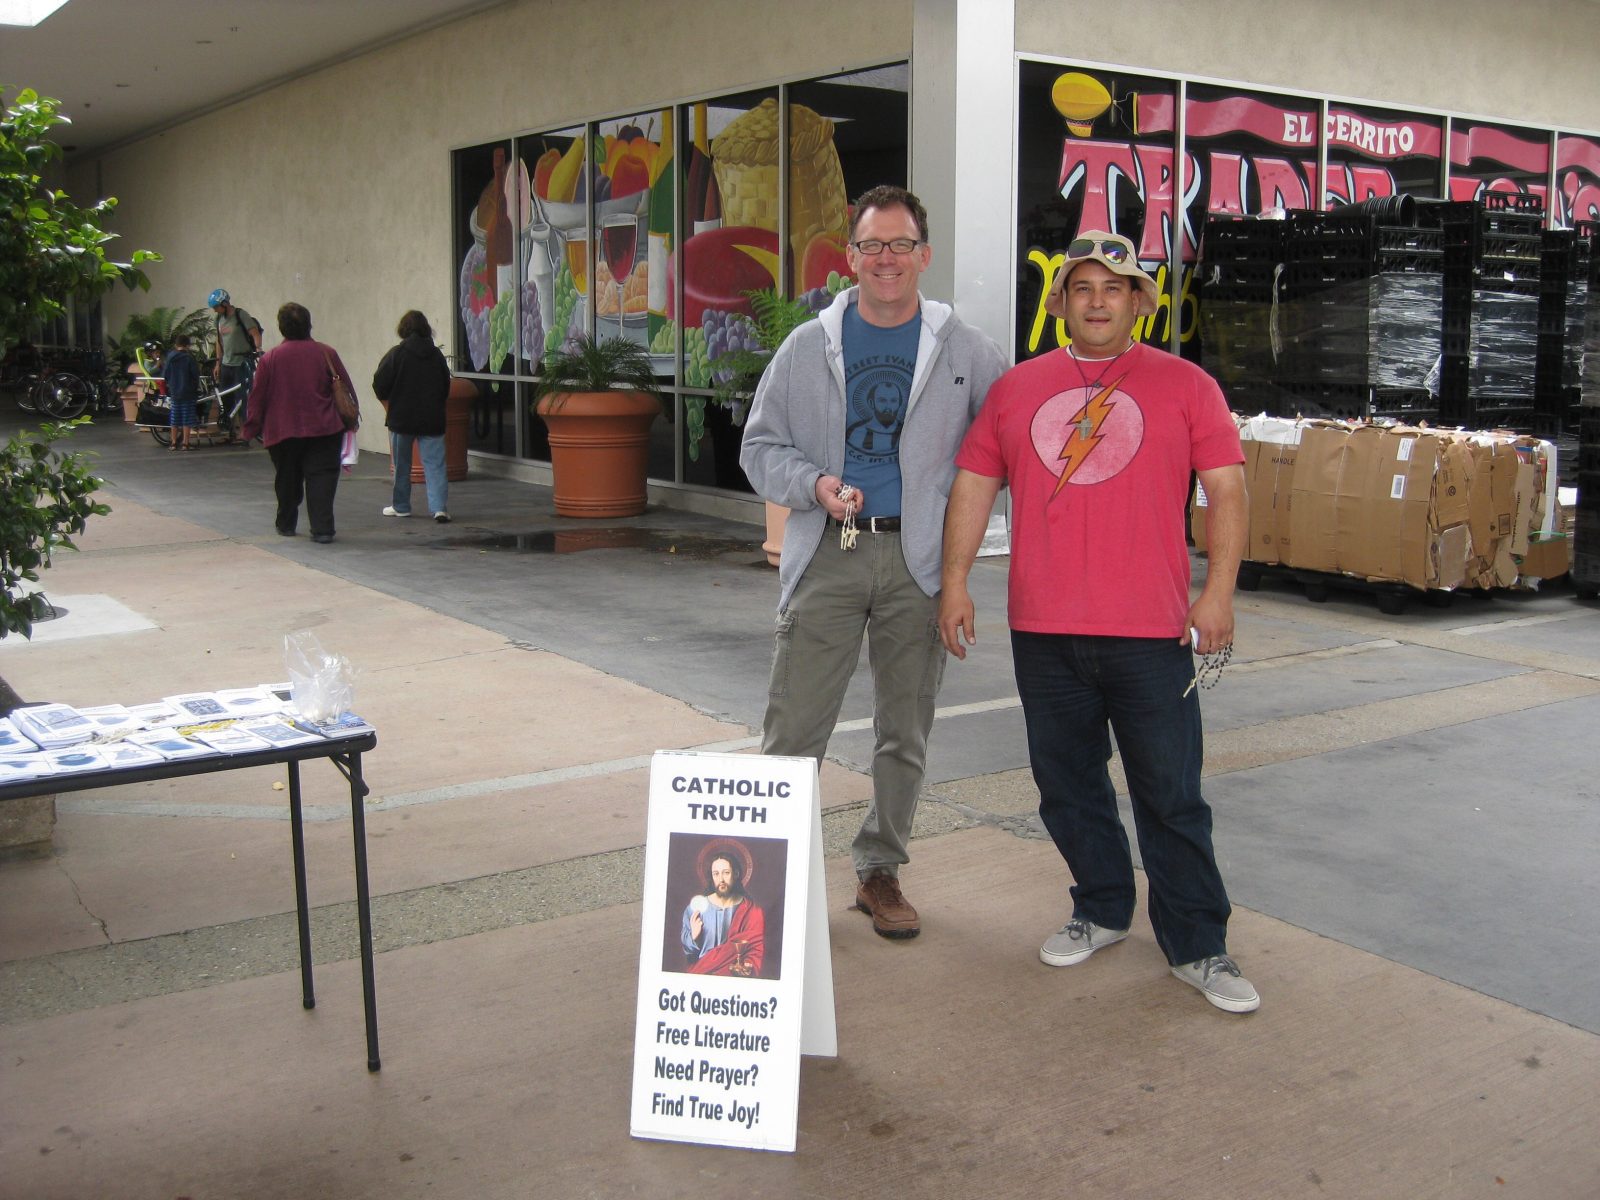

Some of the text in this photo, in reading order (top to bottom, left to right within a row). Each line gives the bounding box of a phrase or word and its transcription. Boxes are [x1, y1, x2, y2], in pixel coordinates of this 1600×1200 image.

[1283, 113, 1414, 155] EL CERRITO
[672, 776, 791, 798] CATHOLIC
[688, 803, 767, 823] TRUTH
[659, 988, 778, 1019] Got Questions?
[656, 1021, 770, 1052] Free Literature
[654, 1056, 759, 1090] Need Prayer?
[652, 1092, 760, 1129] Find True Joy!
